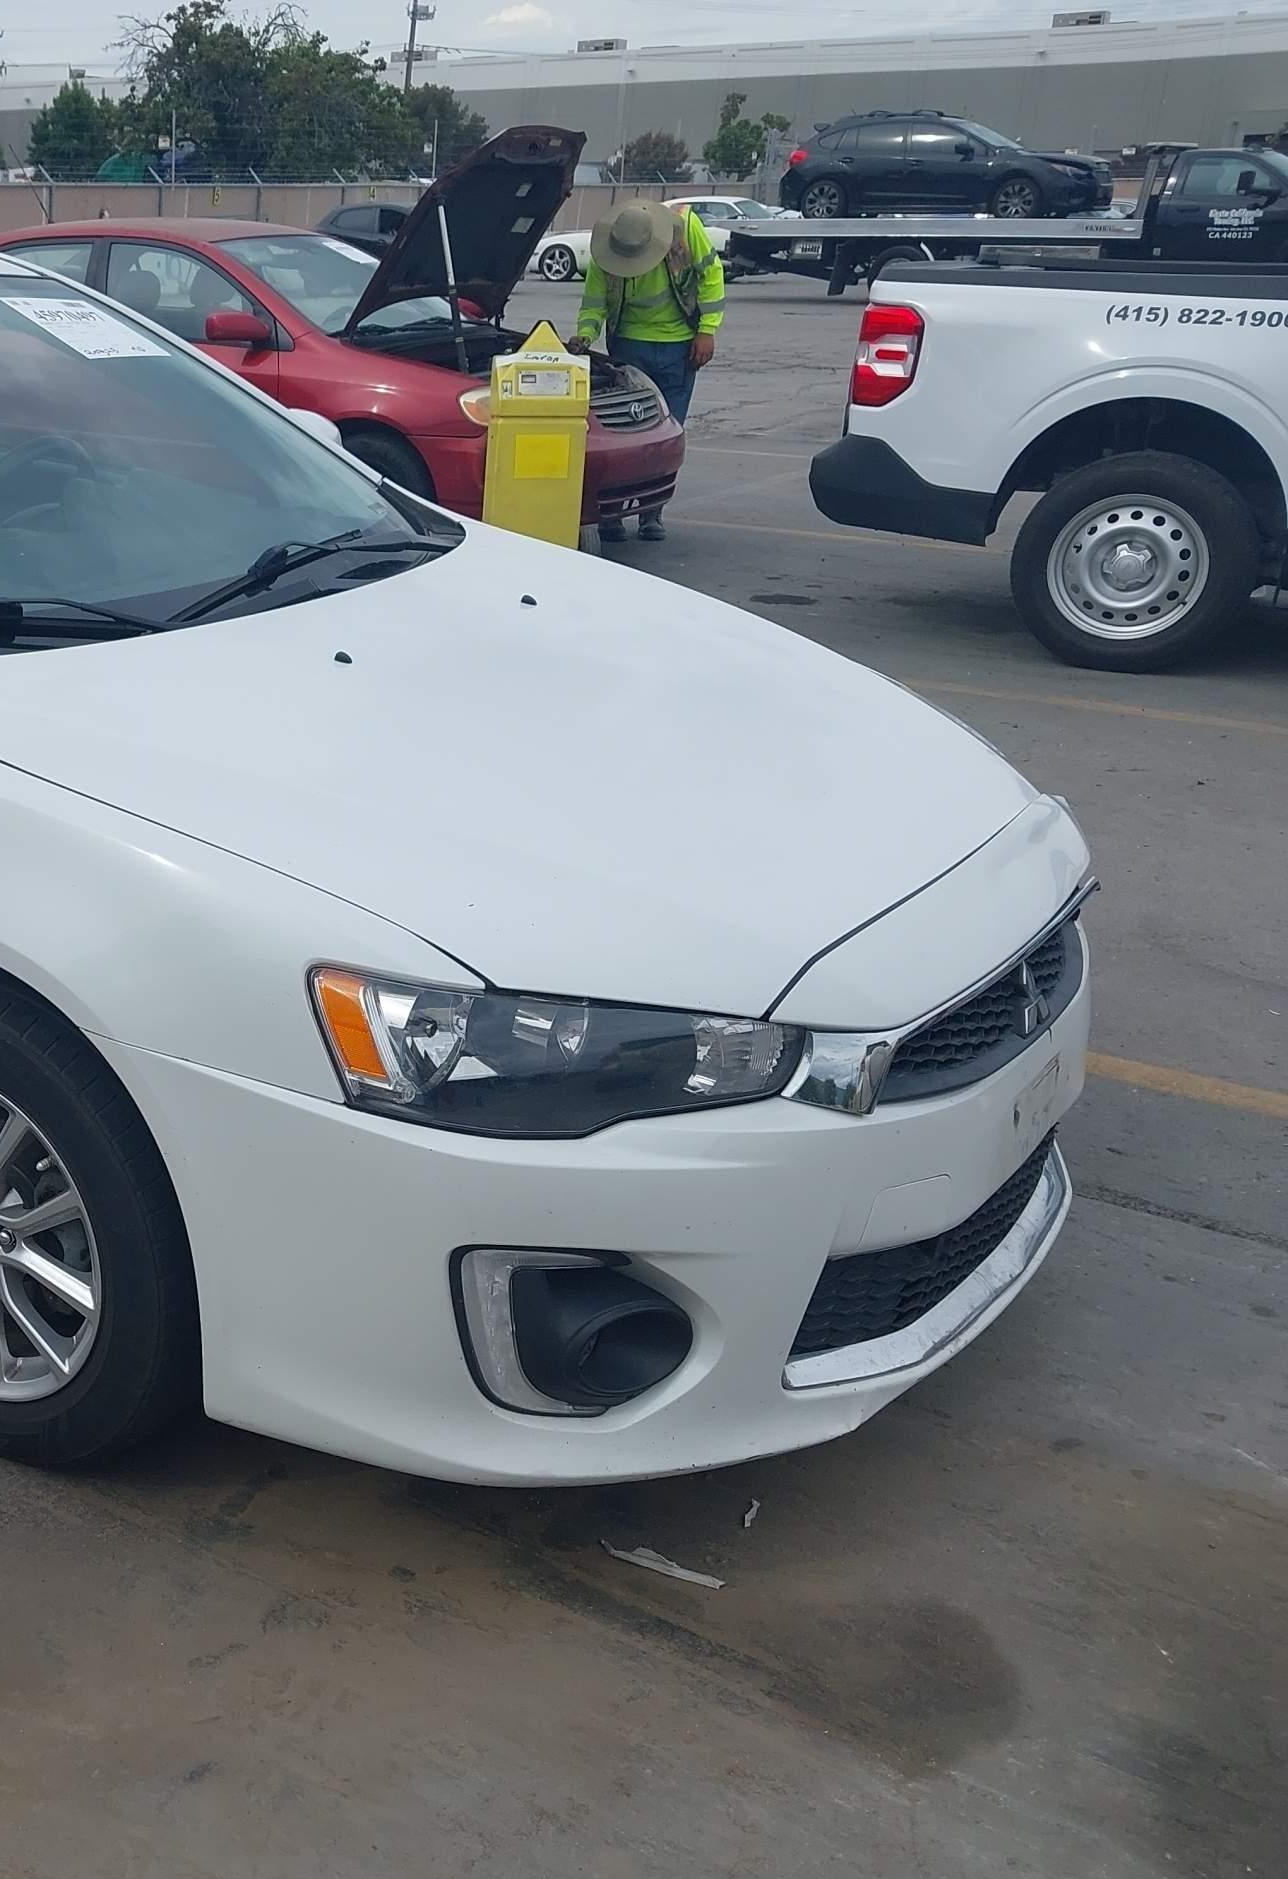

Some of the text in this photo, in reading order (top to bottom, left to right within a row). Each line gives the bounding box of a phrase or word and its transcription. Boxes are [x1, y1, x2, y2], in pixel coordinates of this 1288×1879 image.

[1208, 231, 1253, 239] CA 440123
[1106, 304, 1288, 328] (415) 822-190
